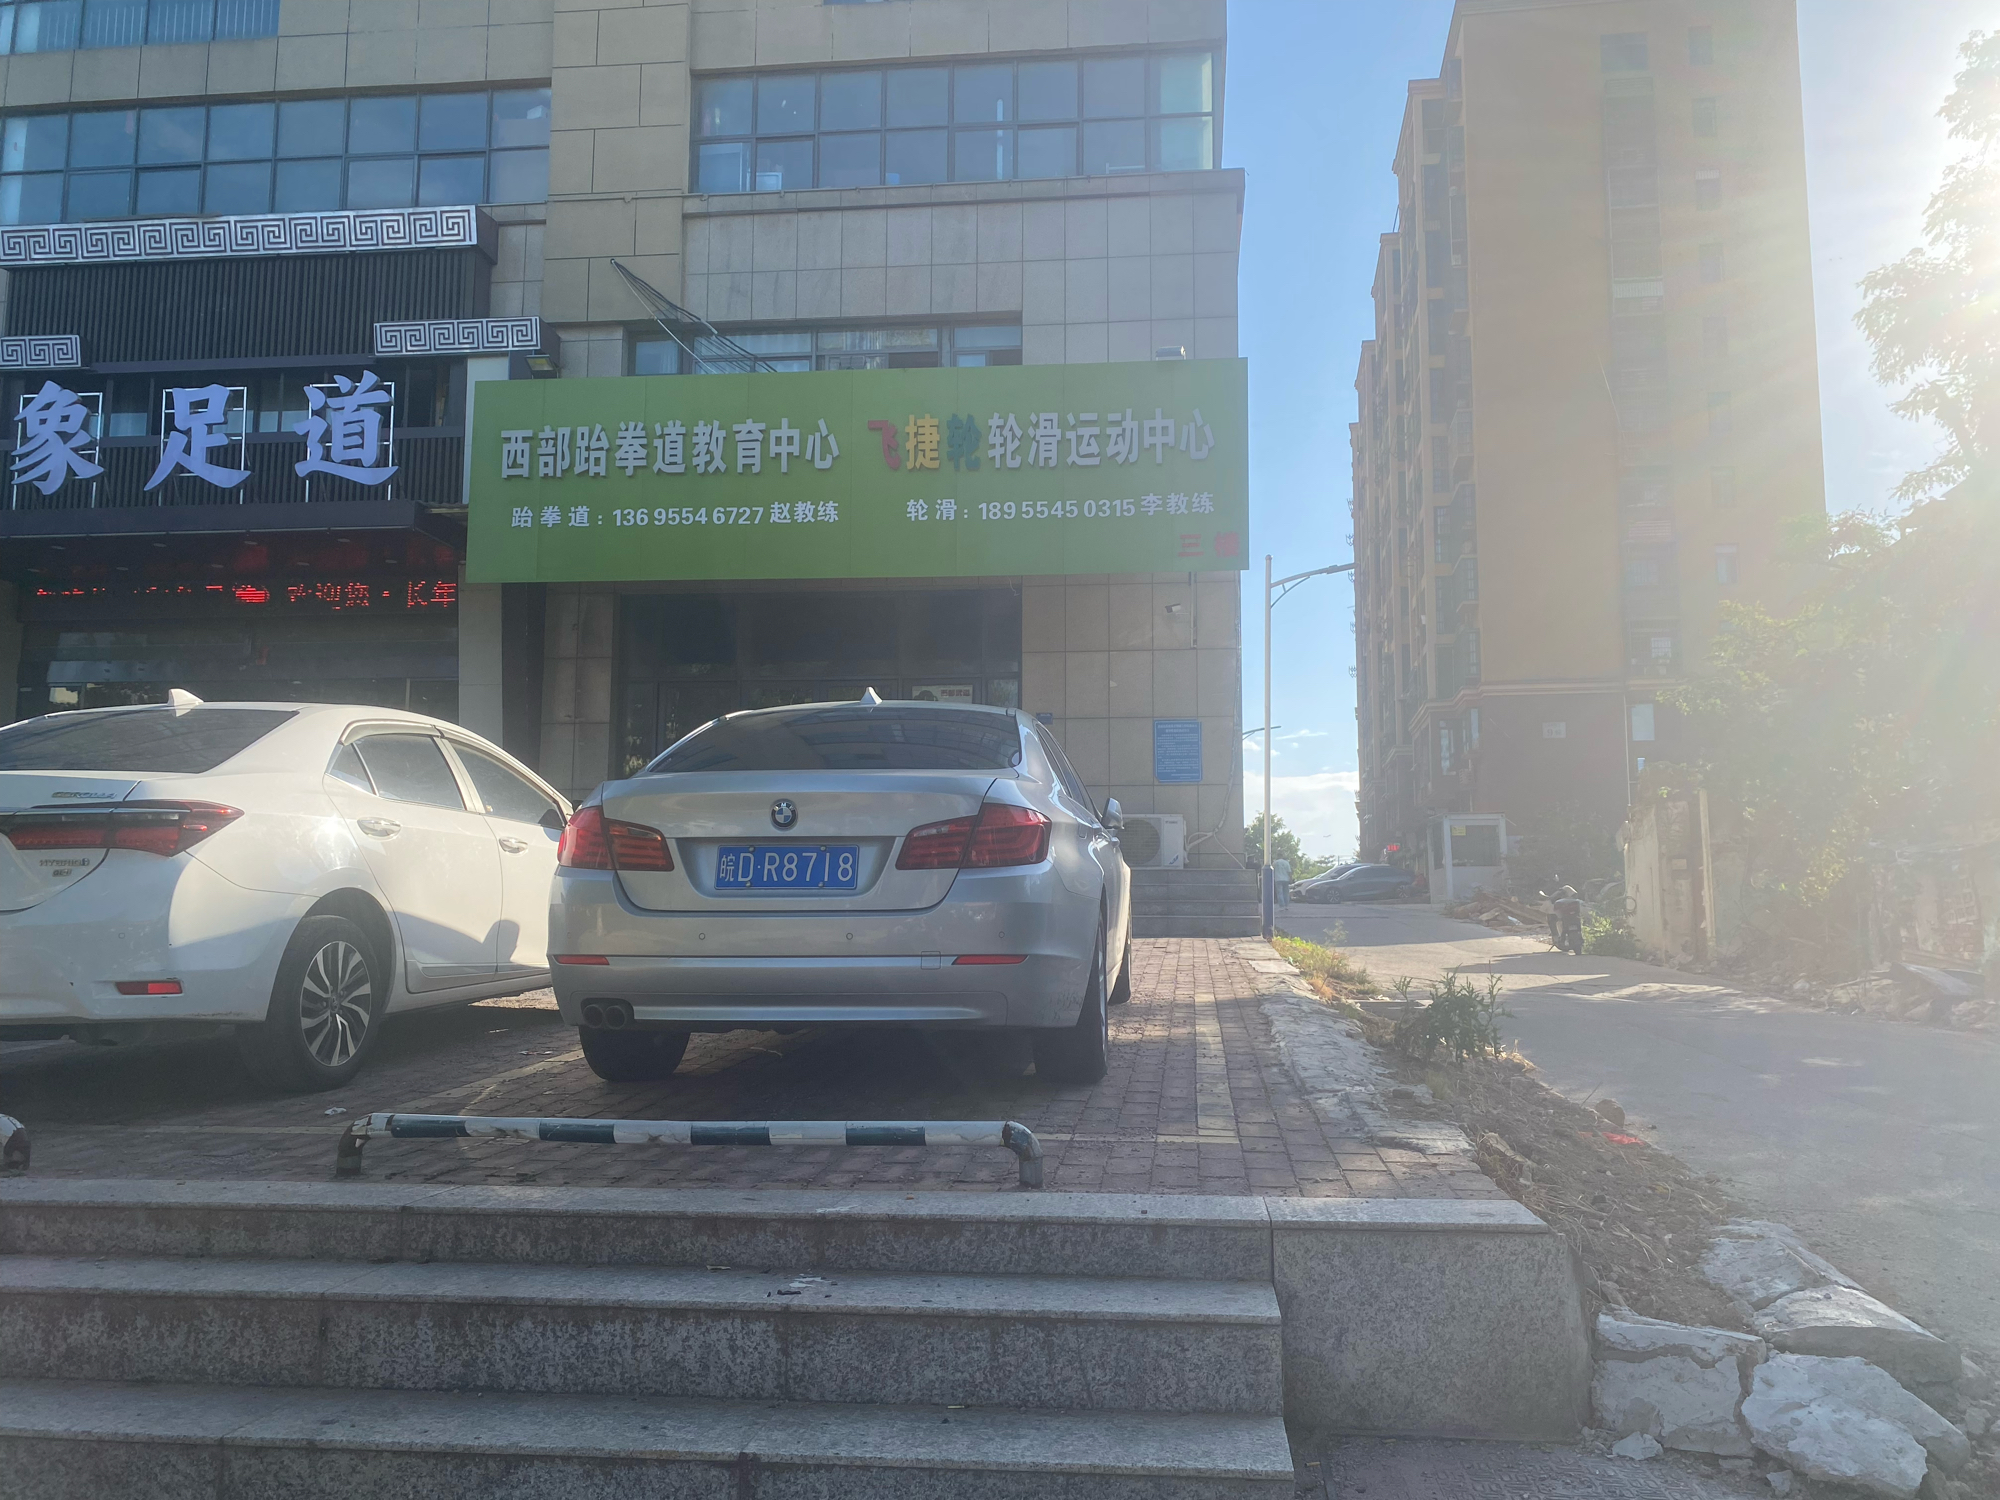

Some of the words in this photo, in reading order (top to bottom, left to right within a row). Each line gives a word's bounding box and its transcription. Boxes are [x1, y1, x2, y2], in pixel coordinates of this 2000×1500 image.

[10, 370, 399, 496] 象足道
[500, 417, 840, 479] 西部跆拳道教育中心
